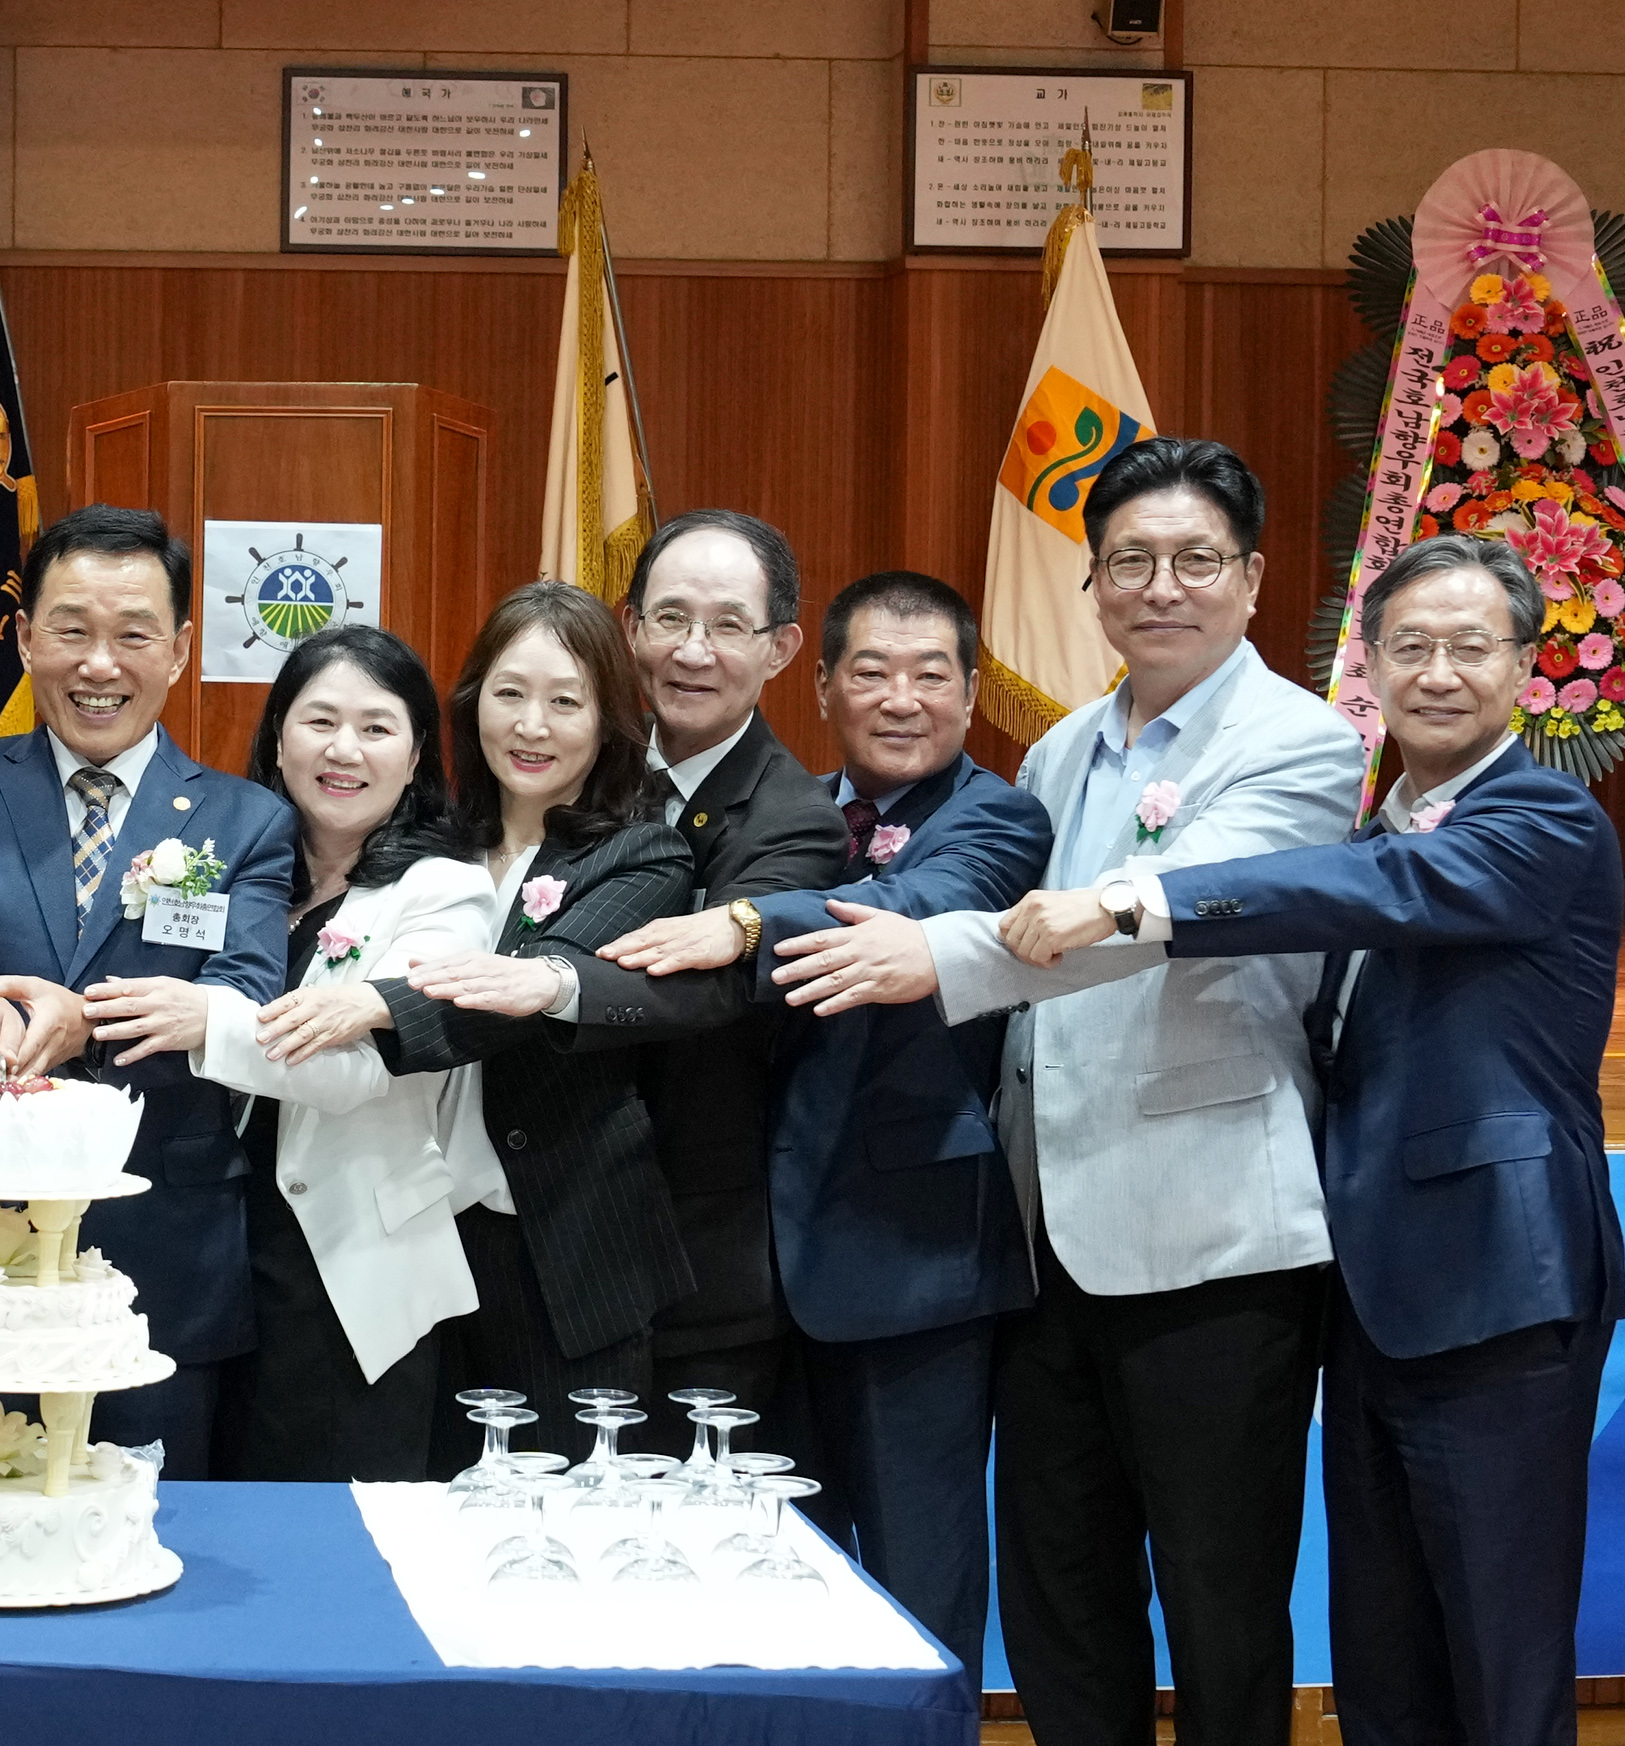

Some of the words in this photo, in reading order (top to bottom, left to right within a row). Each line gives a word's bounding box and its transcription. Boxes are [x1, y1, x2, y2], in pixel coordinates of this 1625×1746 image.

[1410, 313, 1446, 335] 正品
[1574, 304, 1608, 325] 正品
[1584, 333, 1623, 356] 祝
[172, 912, 200, 925] 총회장
